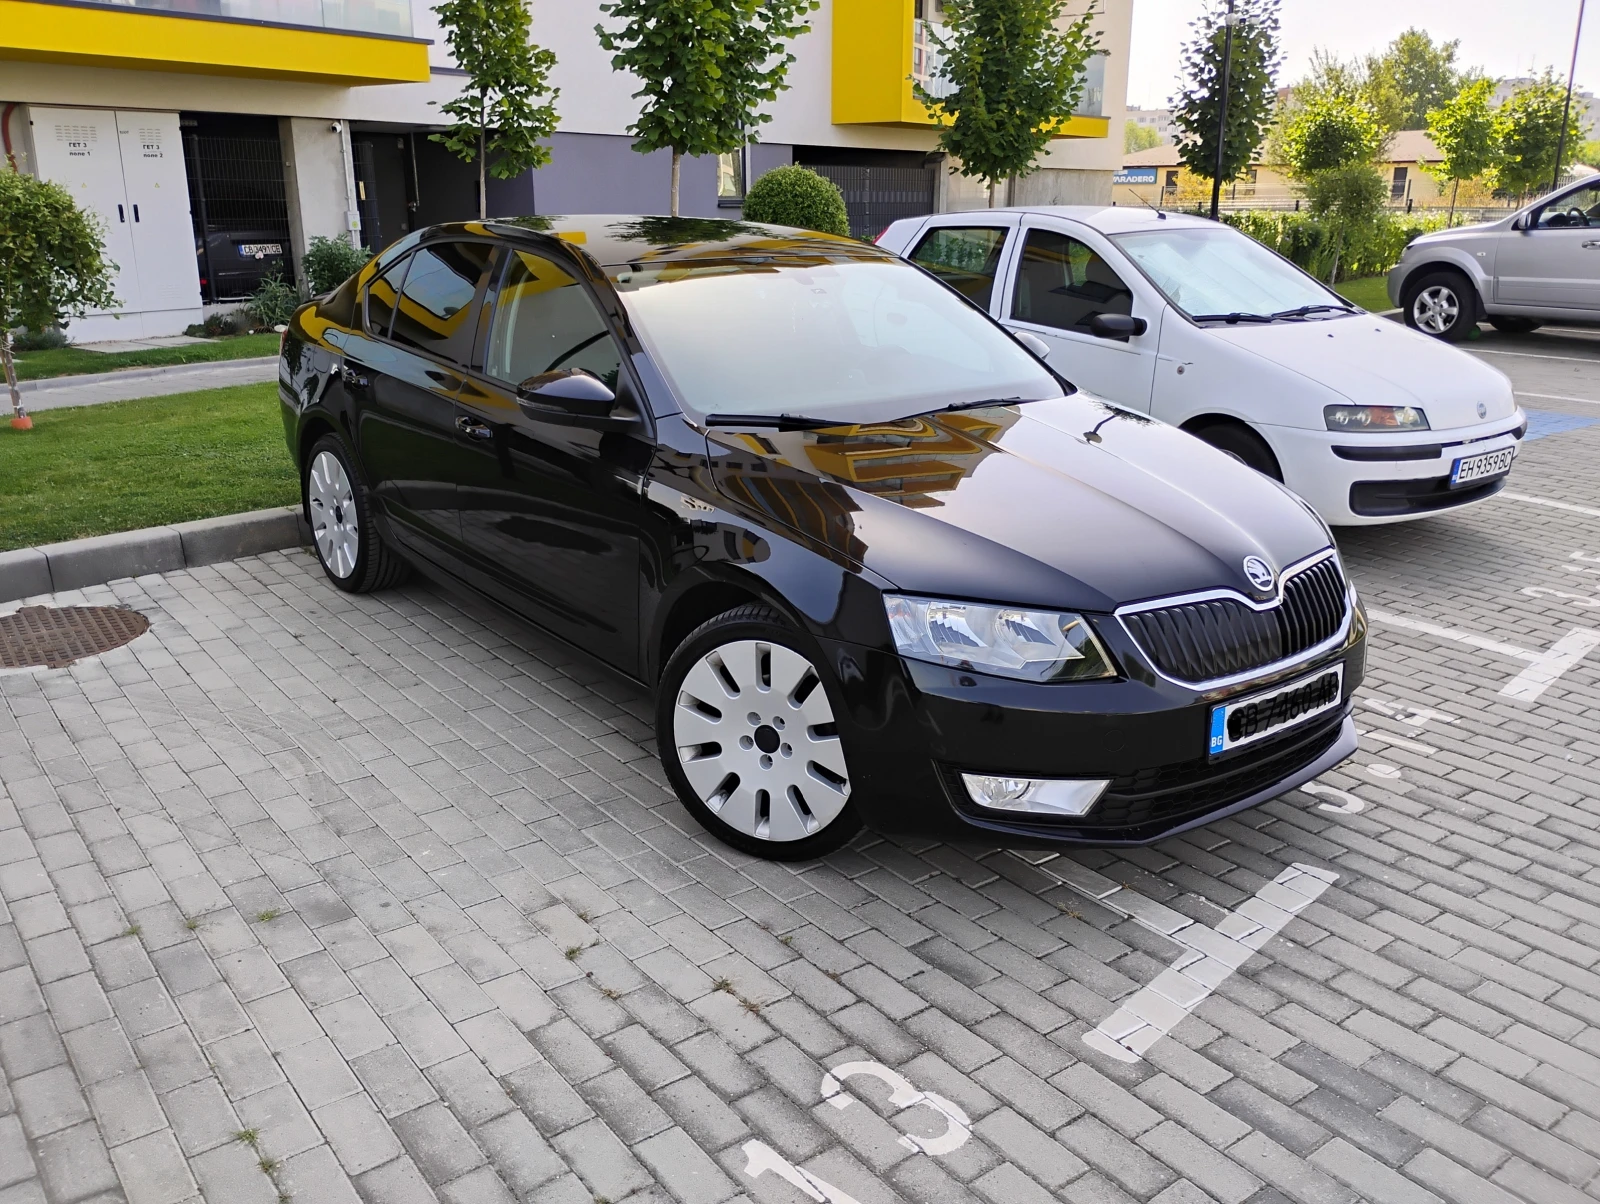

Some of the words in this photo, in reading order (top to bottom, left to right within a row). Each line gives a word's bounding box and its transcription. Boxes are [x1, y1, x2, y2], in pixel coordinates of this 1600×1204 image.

[1459, 460, 1475, 479] EH
[1476, 454, 1499, 476] 9359
[1498, 451, 1512, 470] BC
[1211, 735, 1223, 748] BG
